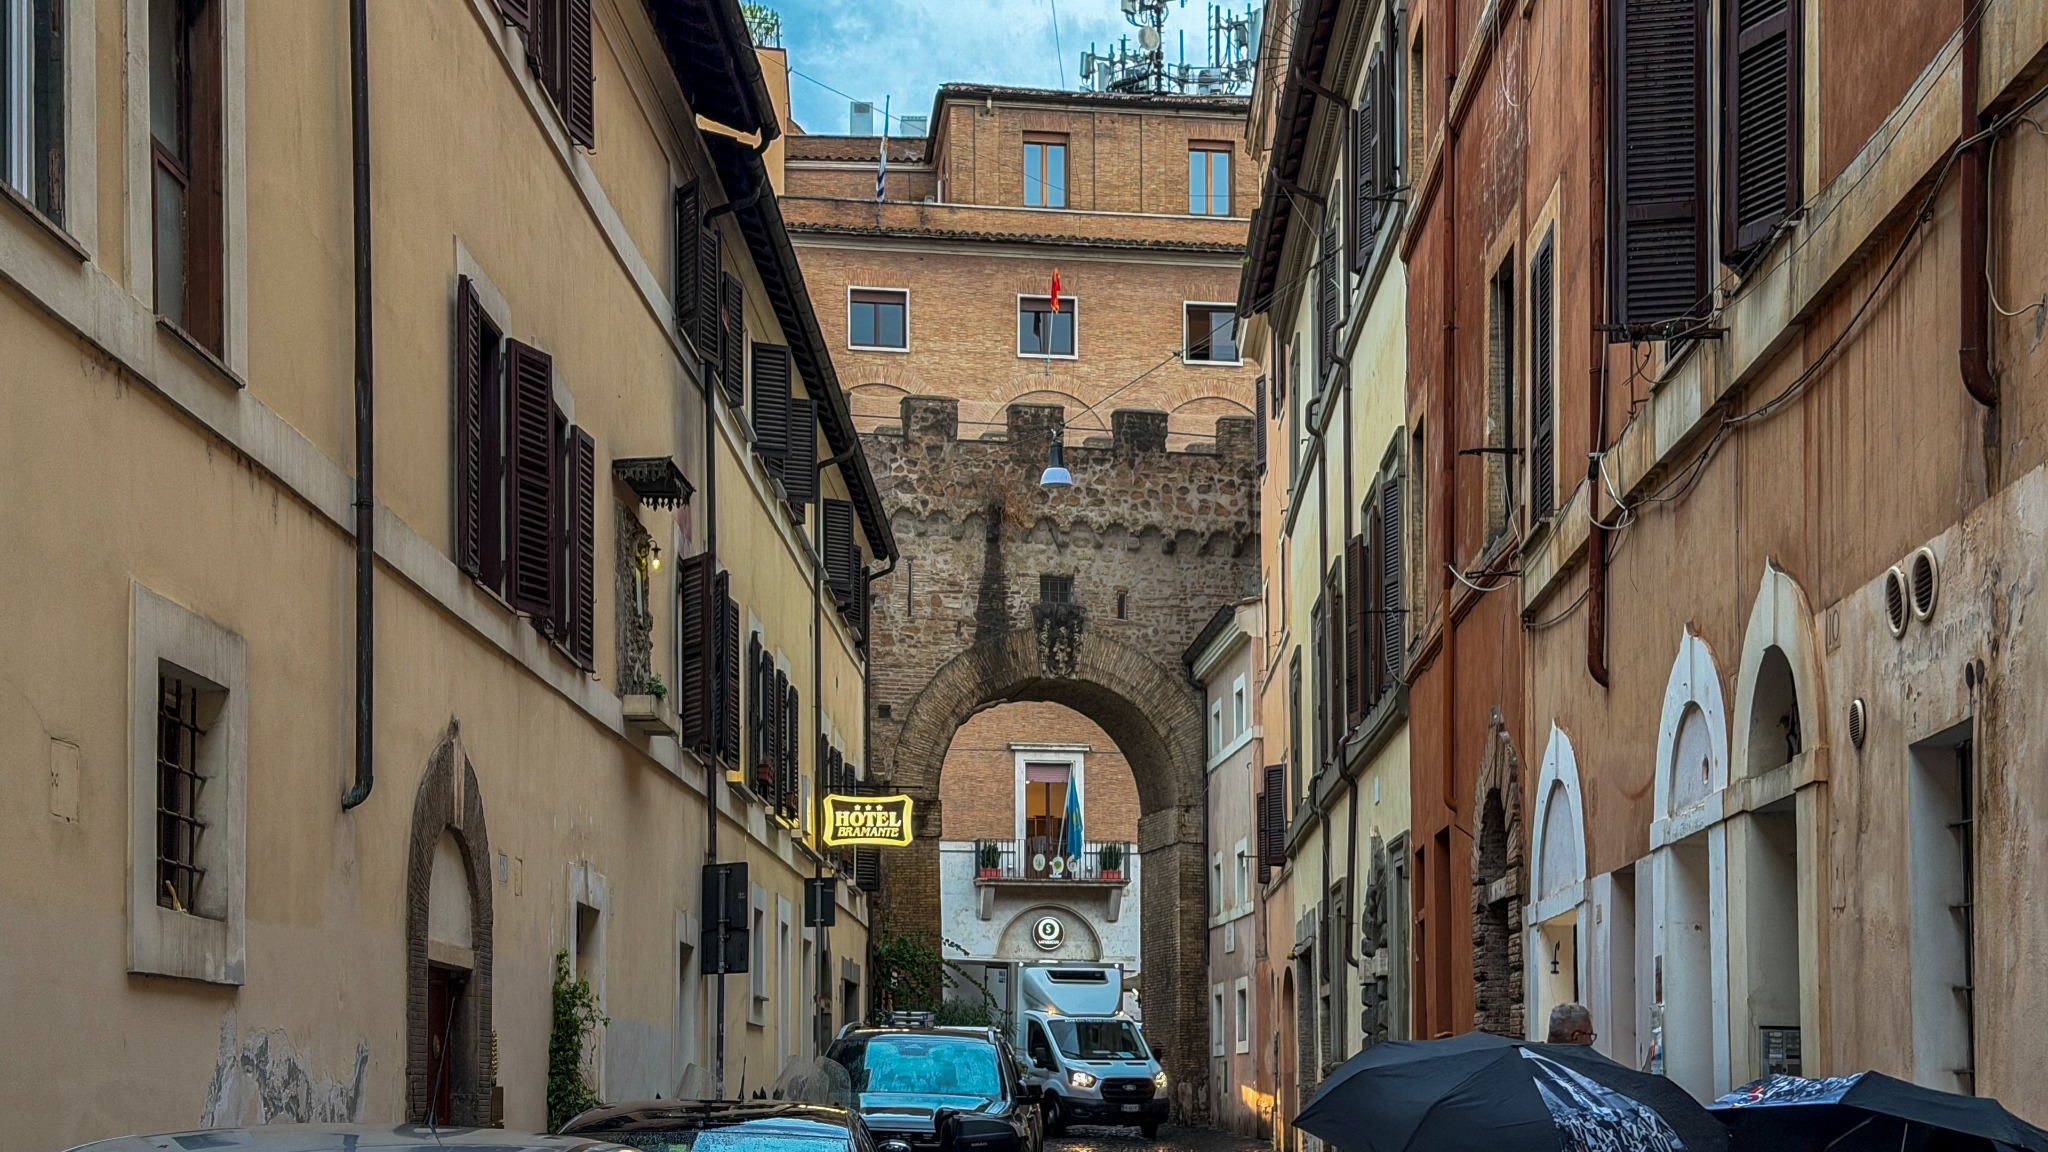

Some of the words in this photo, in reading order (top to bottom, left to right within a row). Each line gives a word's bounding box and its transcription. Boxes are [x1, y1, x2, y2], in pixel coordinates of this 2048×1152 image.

[835, 811, 902, 827] HOTEL
[837, 827, 900, 838] BRAMANTE
[1045, 924, 1052, 934] S
